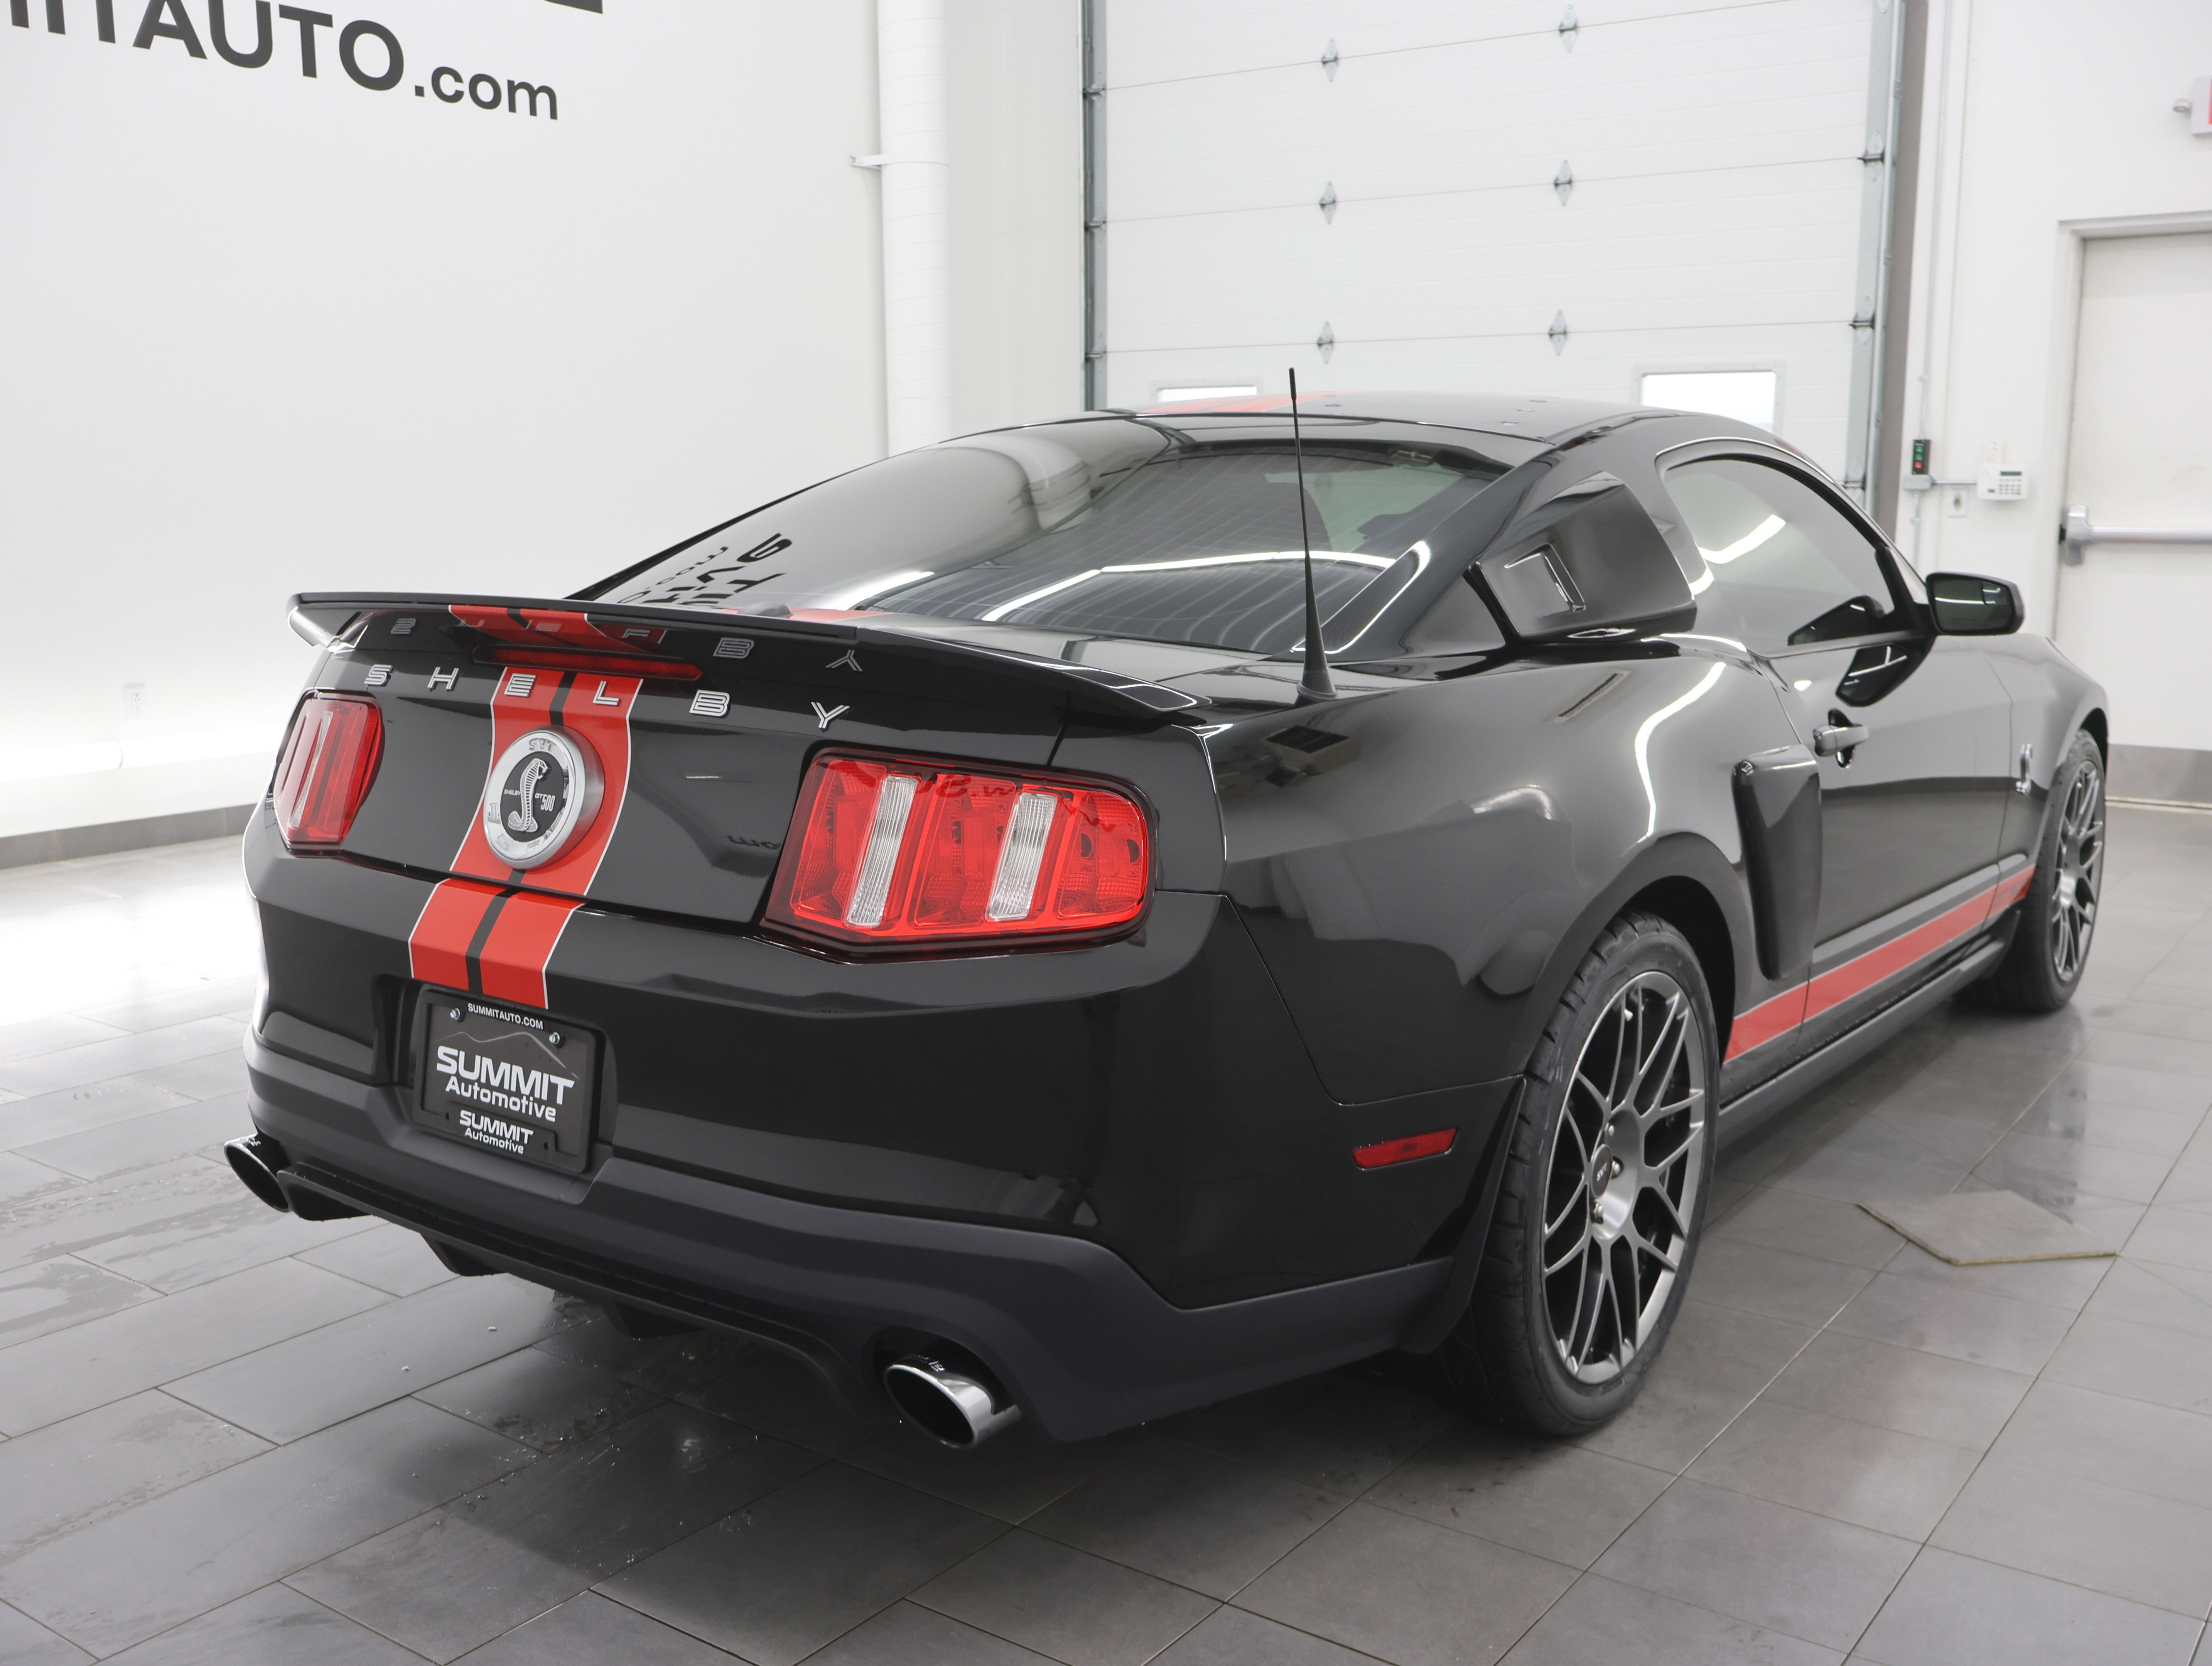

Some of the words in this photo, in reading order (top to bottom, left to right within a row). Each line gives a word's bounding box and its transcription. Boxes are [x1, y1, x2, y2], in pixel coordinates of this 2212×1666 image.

[9, 0, 558, 121] AUTO.com
[364, 664, 850, 730] SHELBY
[468, 1003, 543, 1030] SUMMITAUTO.COM
[437, 1045, 575, 1105] SUMMIT
[445, 1076, 556, 1122] Automotive
[460, 1110, 533, 1144] SUMMIT
[464, 1128, 524, 1154] Automotive
